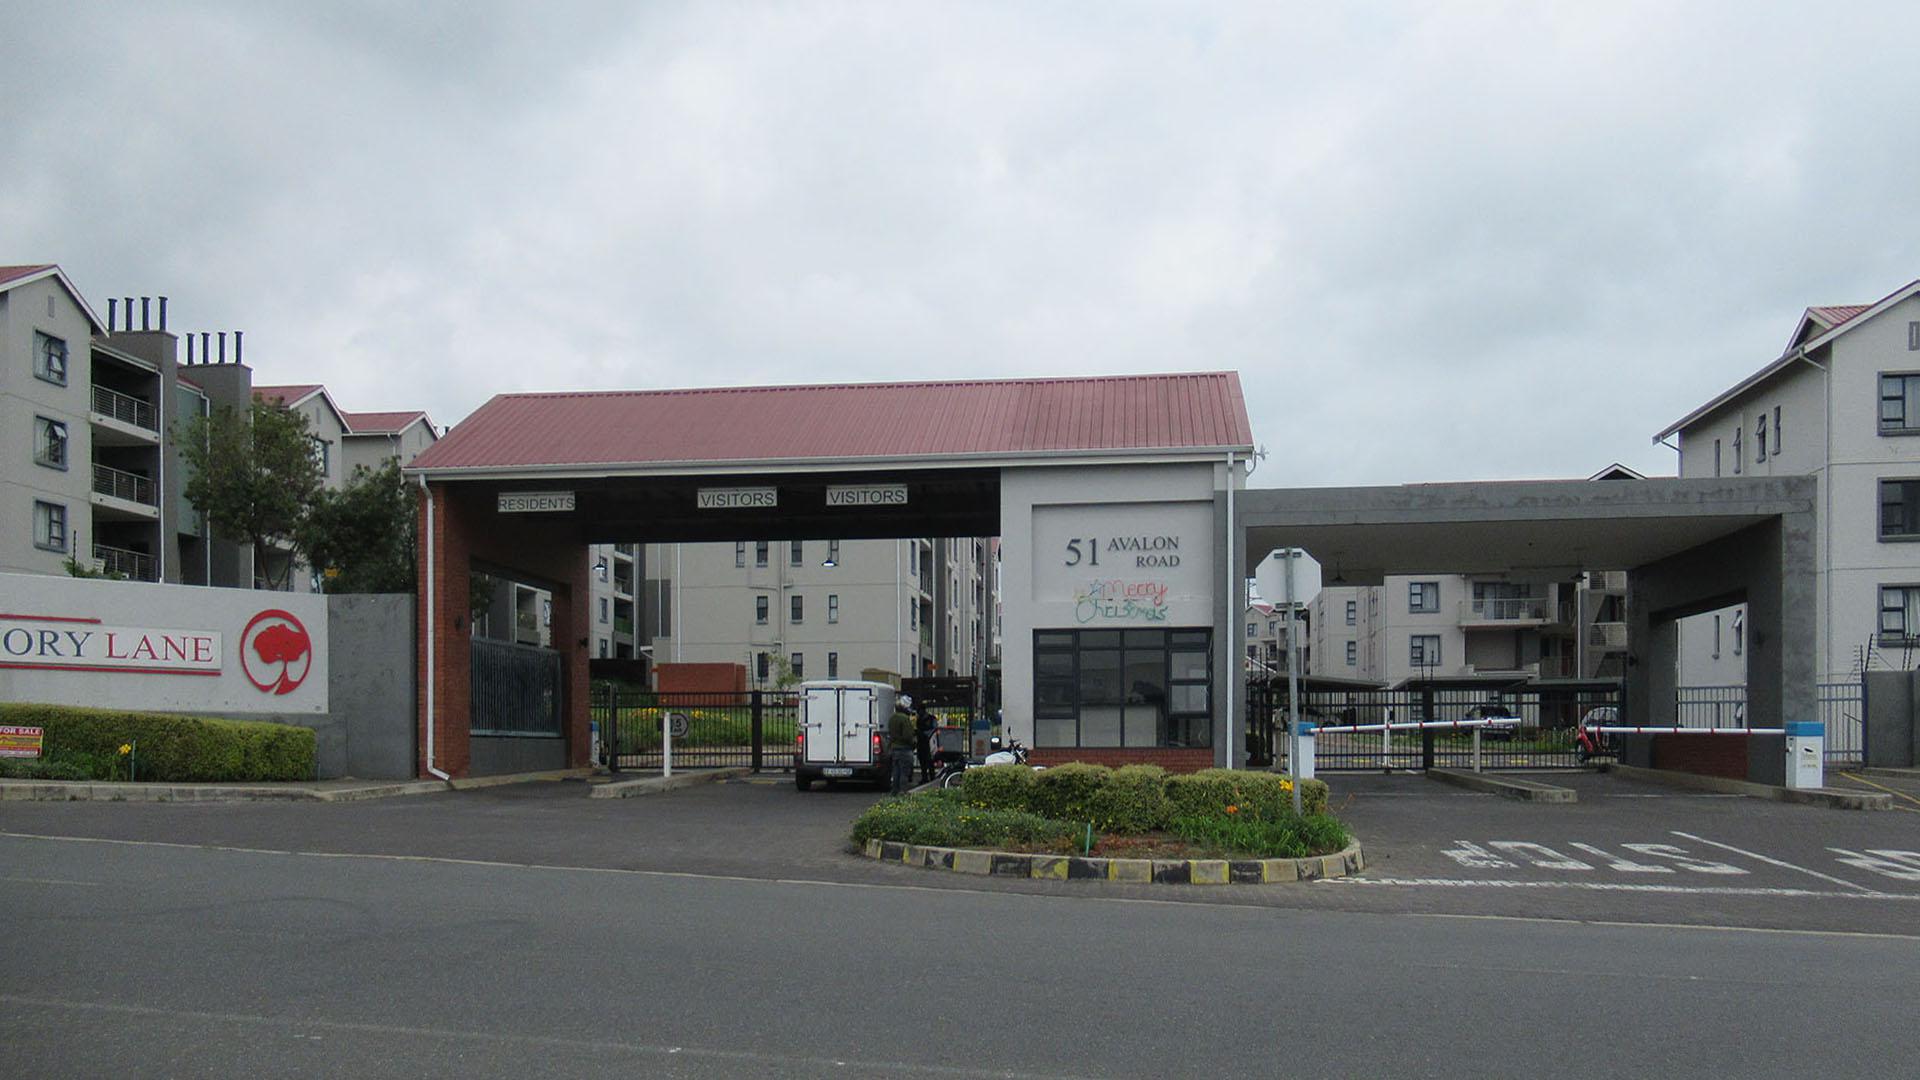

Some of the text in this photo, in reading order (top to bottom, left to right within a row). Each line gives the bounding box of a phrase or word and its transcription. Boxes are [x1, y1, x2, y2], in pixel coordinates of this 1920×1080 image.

[498, 497, 575, 510] RESIDENTS
[700, 492, 775, 507] VISITORS
[829, 489, 906, 504] VISITORS
[1065, 536, 1180, 566] 51 AVALON
[1136, 555, 1181, 568] ROAD
[105, 632, 214, 663] LANE
[18, 728, 41, 736] SALE
